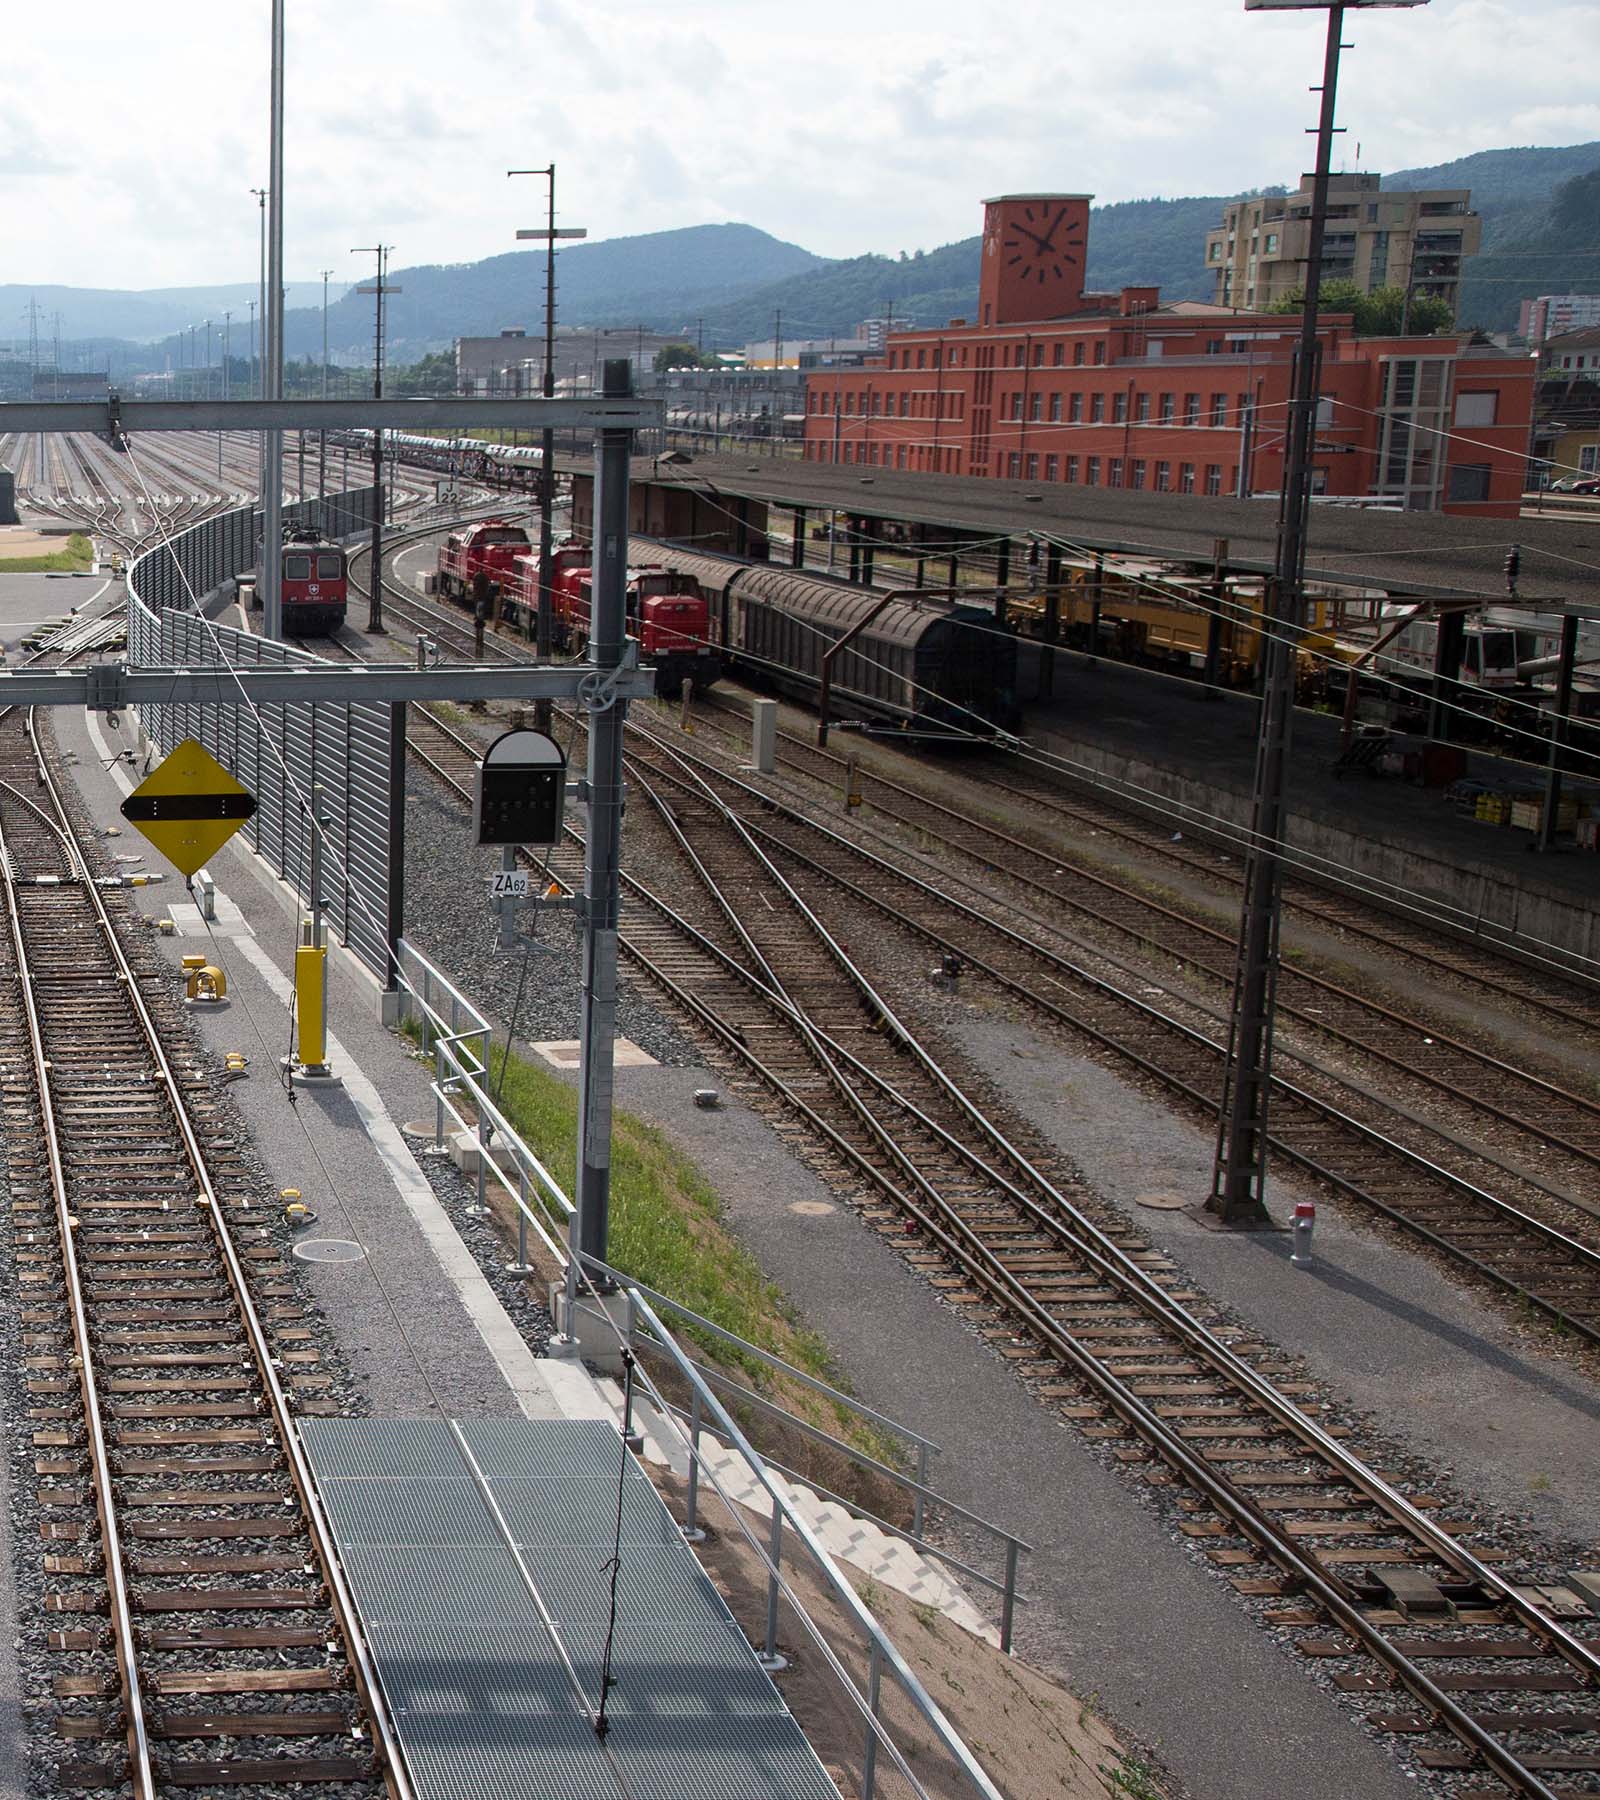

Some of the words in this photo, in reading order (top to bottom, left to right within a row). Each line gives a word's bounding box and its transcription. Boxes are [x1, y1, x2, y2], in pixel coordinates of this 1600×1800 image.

[446, 482, 453, 492] J
[441, 493, 458, 503] 22
[494, 875, 526, 892] ZA62
